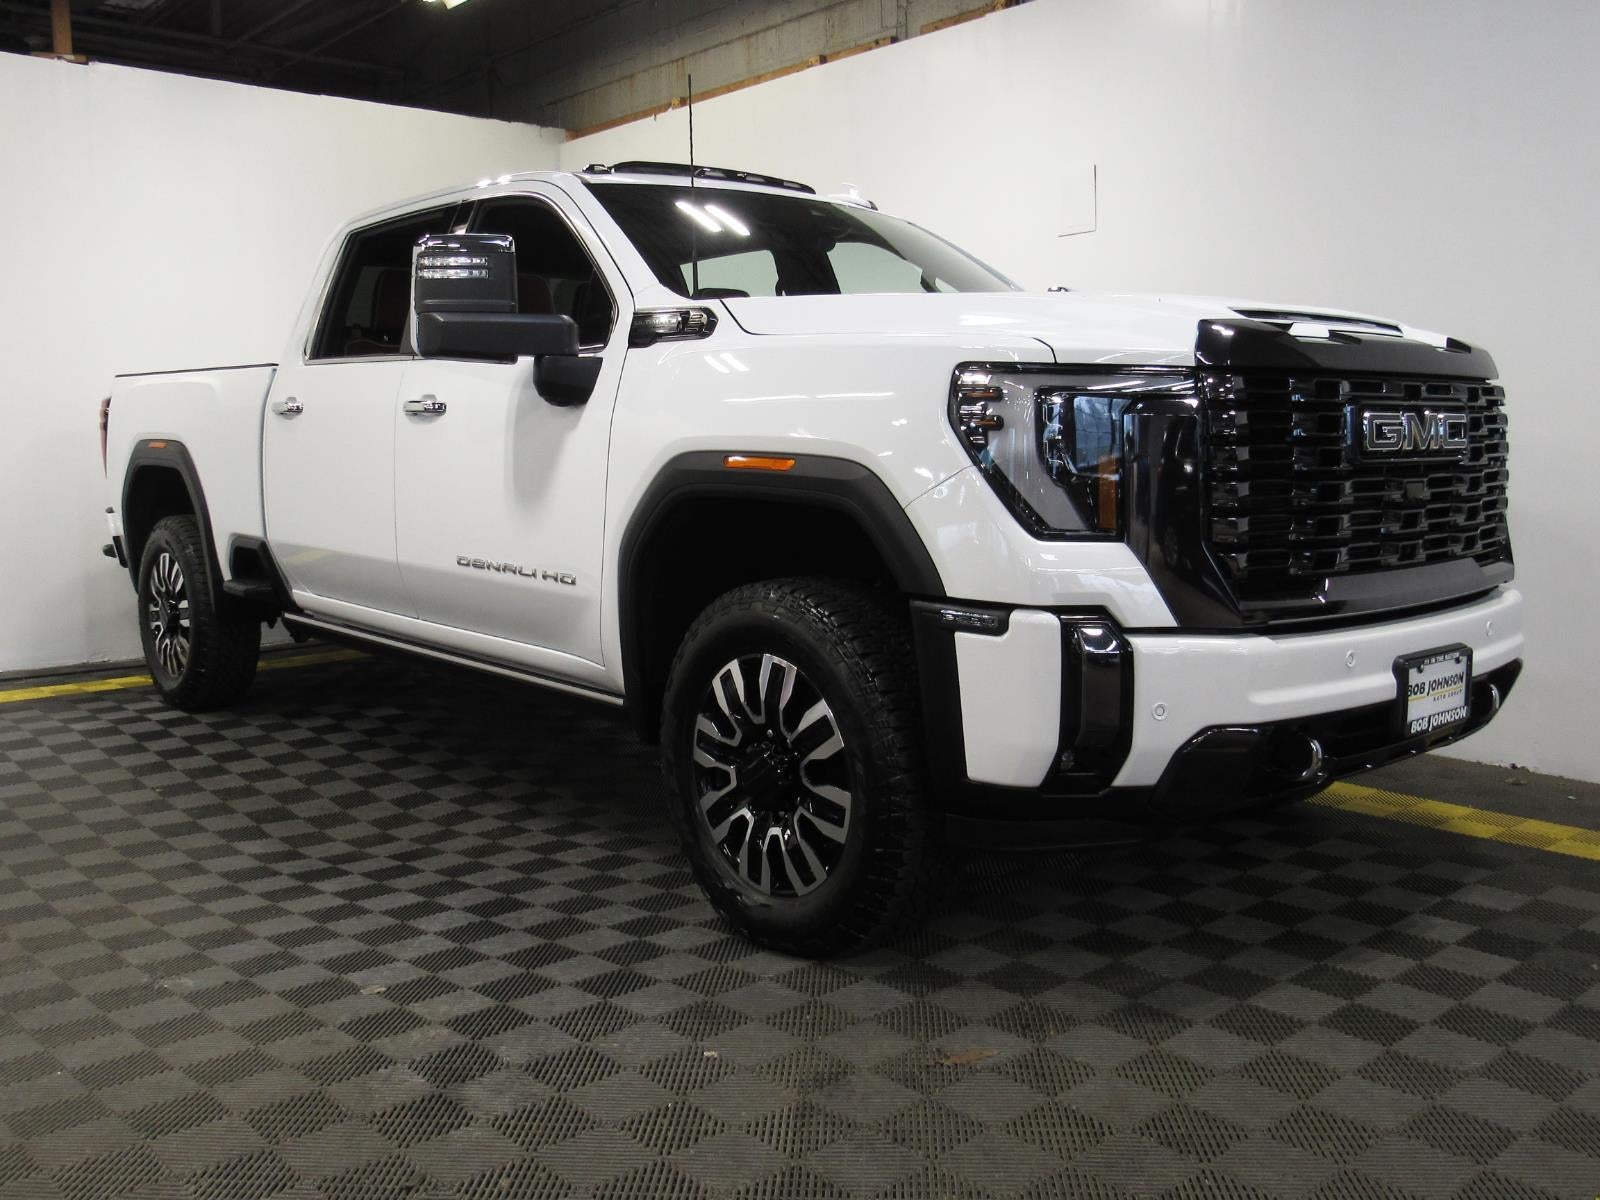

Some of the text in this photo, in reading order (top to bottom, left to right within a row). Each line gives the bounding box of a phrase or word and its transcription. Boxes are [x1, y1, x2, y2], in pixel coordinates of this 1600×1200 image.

[1364, 411, 1467, 450] GMC
[456, 555, 577, 586] DENALI HD
[1408, 672, 1464, 697] BOB JOHNSON
[1411, 706, 1467, 733] BOB JOHNSON
